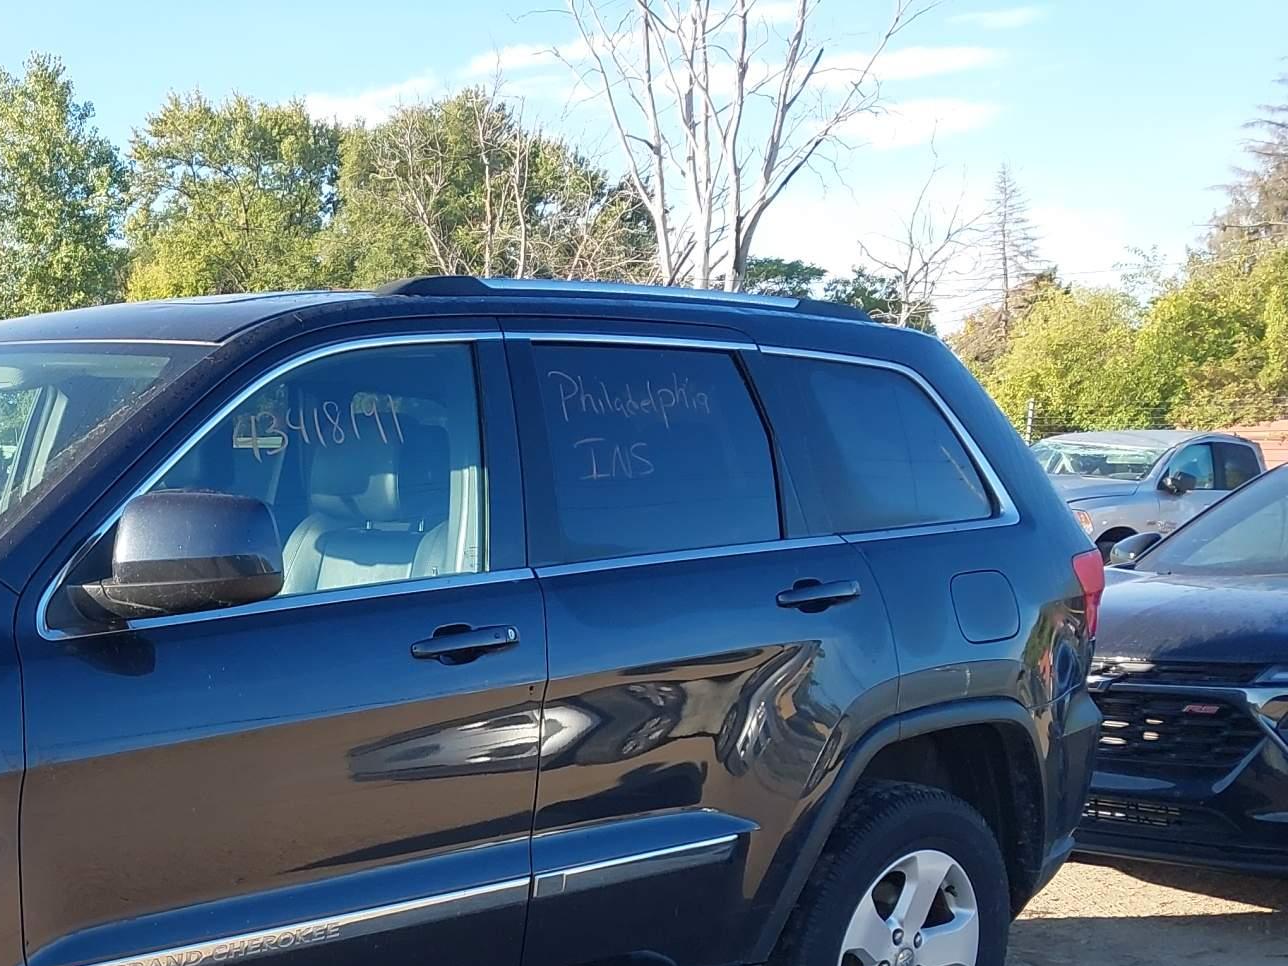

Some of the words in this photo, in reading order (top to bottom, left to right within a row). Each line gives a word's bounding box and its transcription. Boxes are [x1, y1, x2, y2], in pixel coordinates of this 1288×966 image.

[547, 370, 711, 429] Philadelphia
[233, 392, 405, 462] 43418191
[573, 437, 655, 480] INS
[212, 921, 341, 961] CHEROKEE
